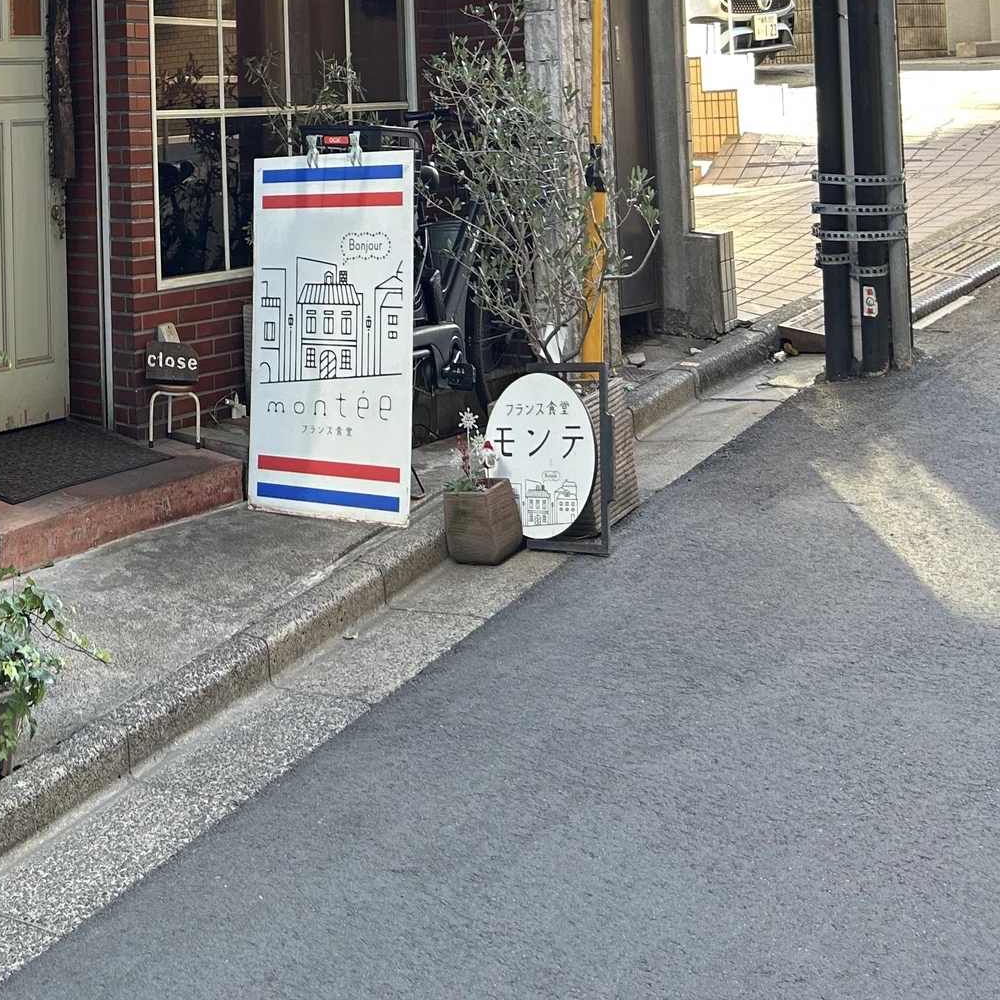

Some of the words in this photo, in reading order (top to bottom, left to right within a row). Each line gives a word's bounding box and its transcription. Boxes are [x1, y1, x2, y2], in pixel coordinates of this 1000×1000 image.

[348, 238, 382, 254] Bonjour
[147, 351, 198, 371] close
[266, 390, 392, 421] montée
[506, 400, 570, 416] フランス食堂
[302, 423, 353, 437] フランス食堂
[494, 425, 584, 458] モンテ
